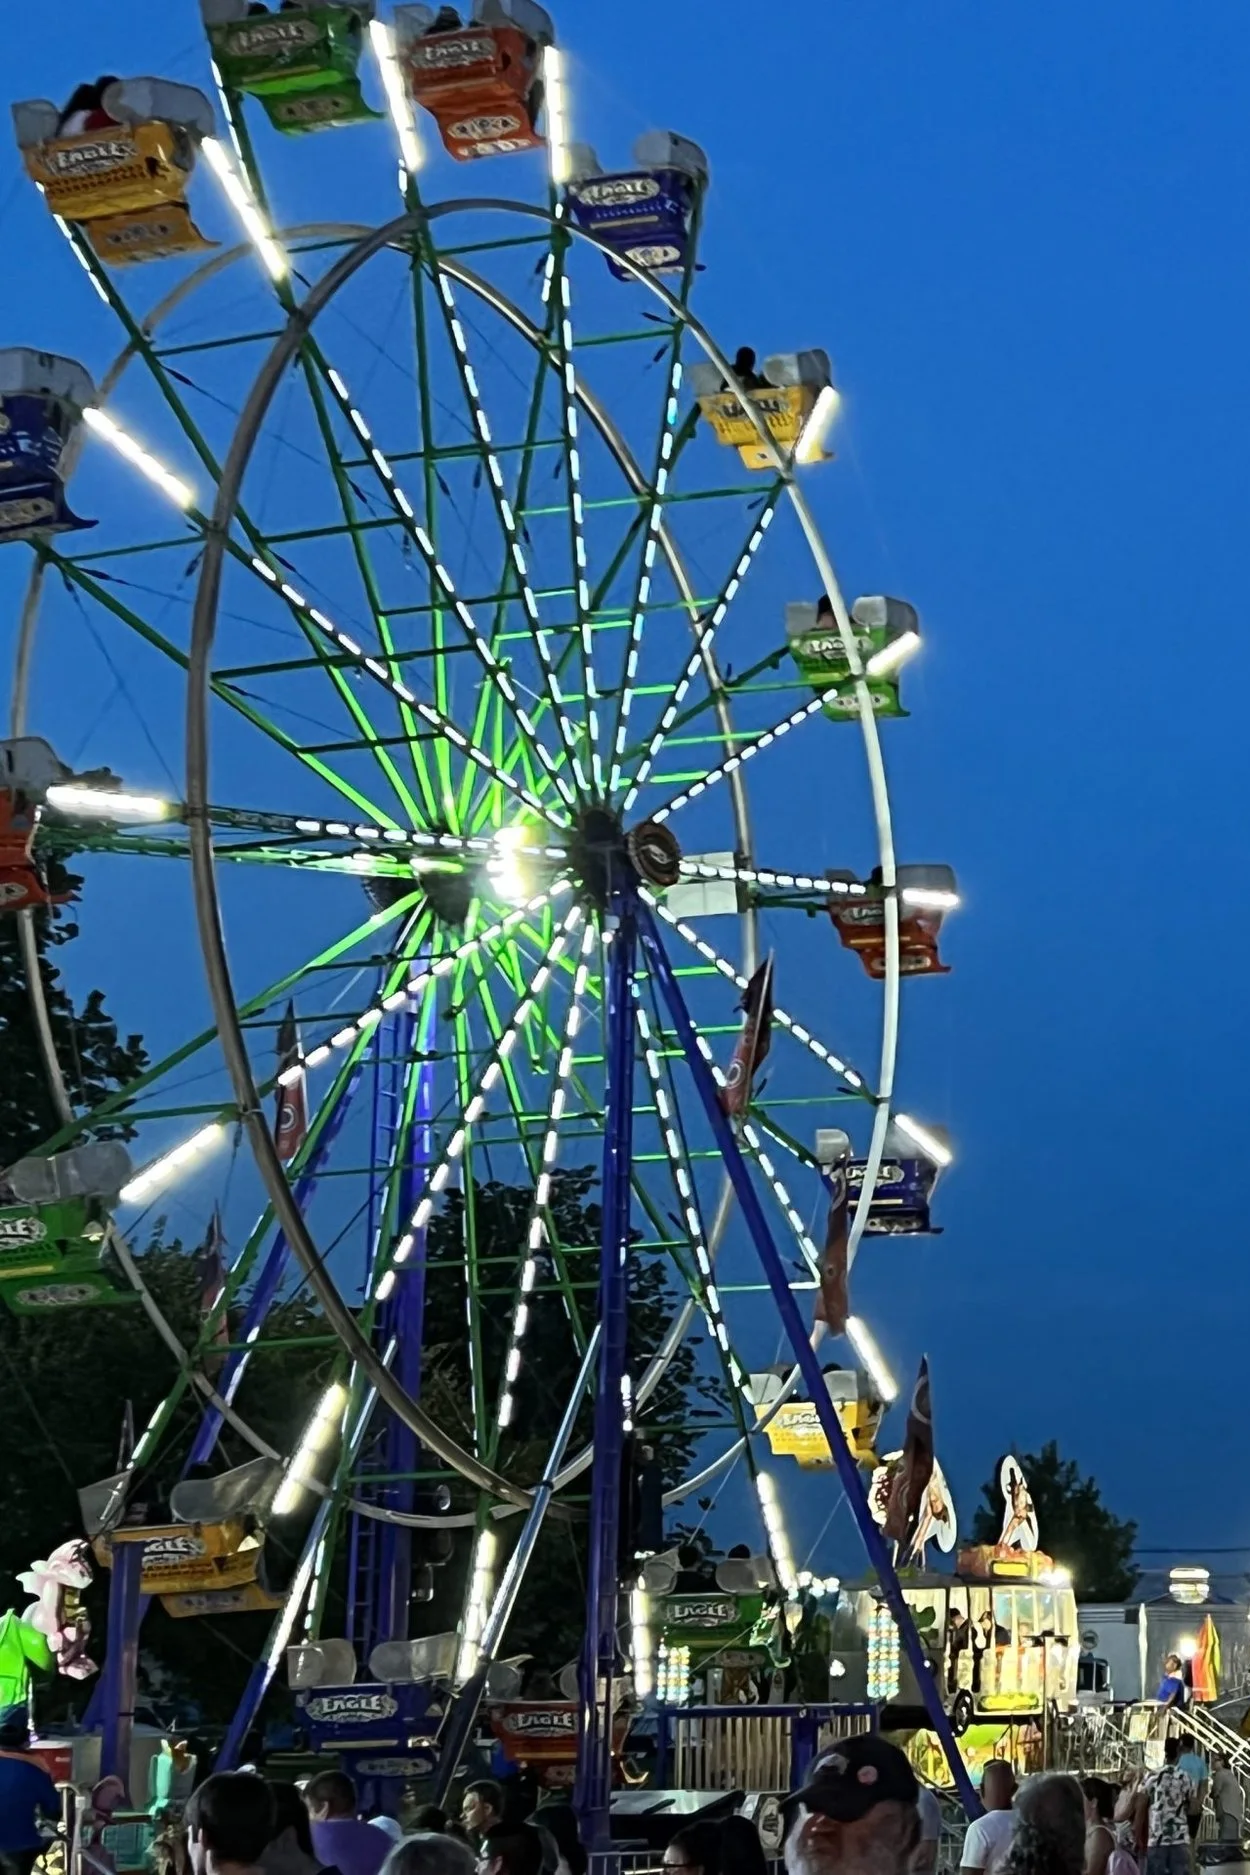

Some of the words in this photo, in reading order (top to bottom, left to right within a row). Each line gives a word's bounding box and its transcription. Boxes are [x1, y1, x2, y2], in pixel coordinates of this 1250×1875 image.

[674, 1602, 727, 1618] EAGLE
[321, 1695, 381, 1712] EAGLE
[517, 1711, 574, 1727] EAGLE
